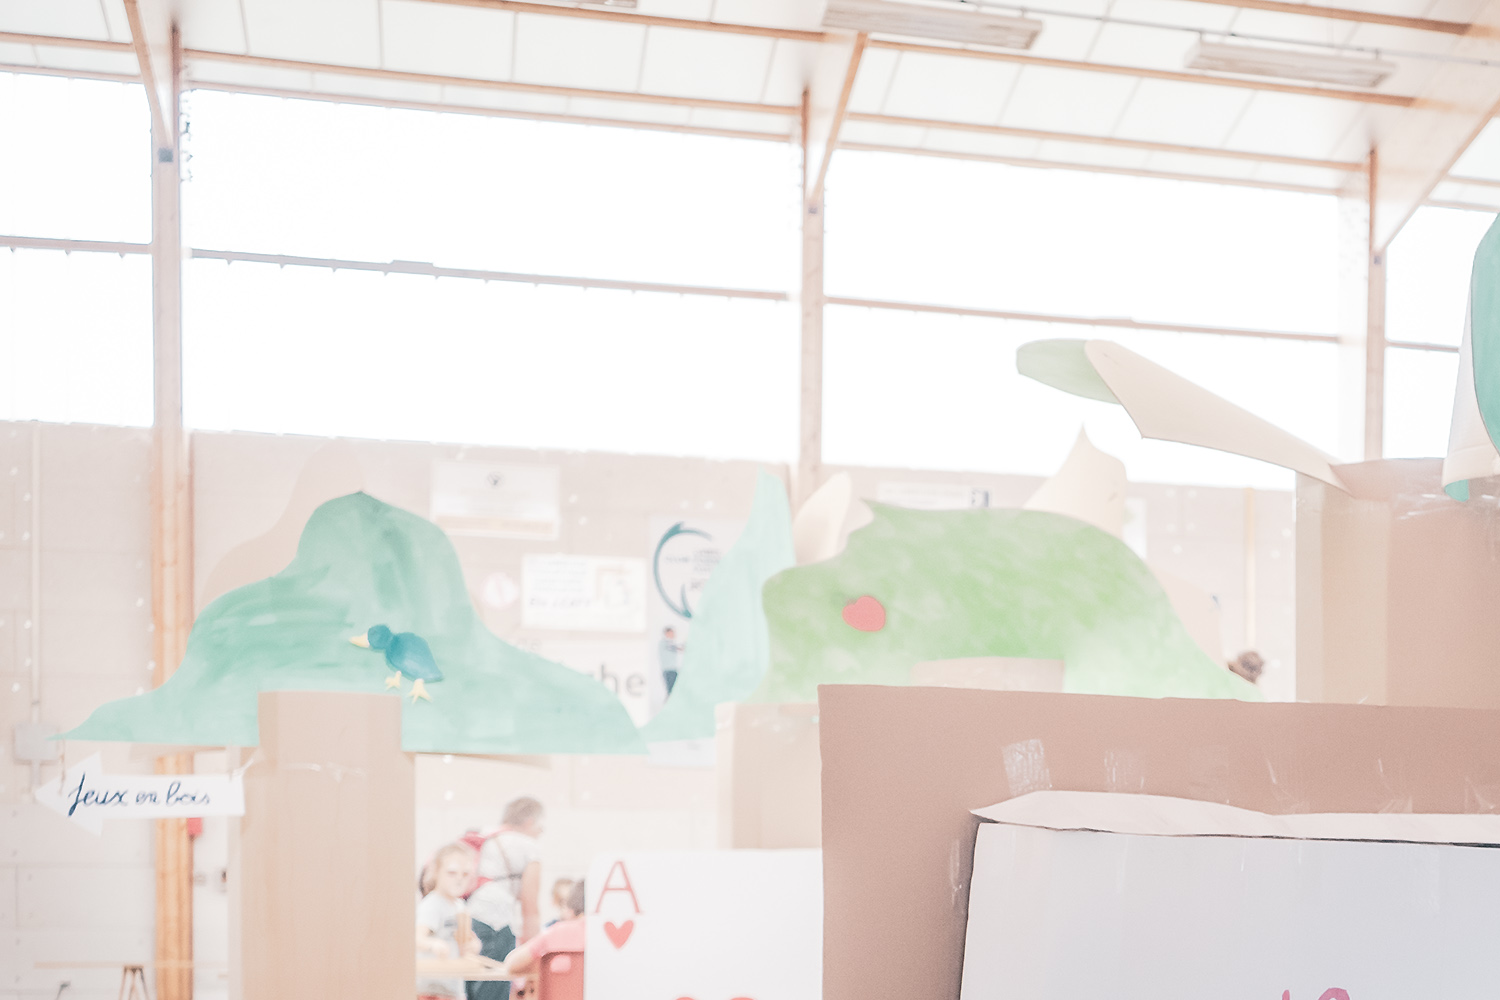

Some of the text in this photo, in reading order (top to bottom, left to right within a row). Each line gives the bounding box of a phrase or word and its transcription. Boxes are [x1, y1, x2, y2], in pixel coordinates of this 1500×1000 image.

[67, 771, 211, 818] Jeux en bois
[593, 860, 644, 915] A
